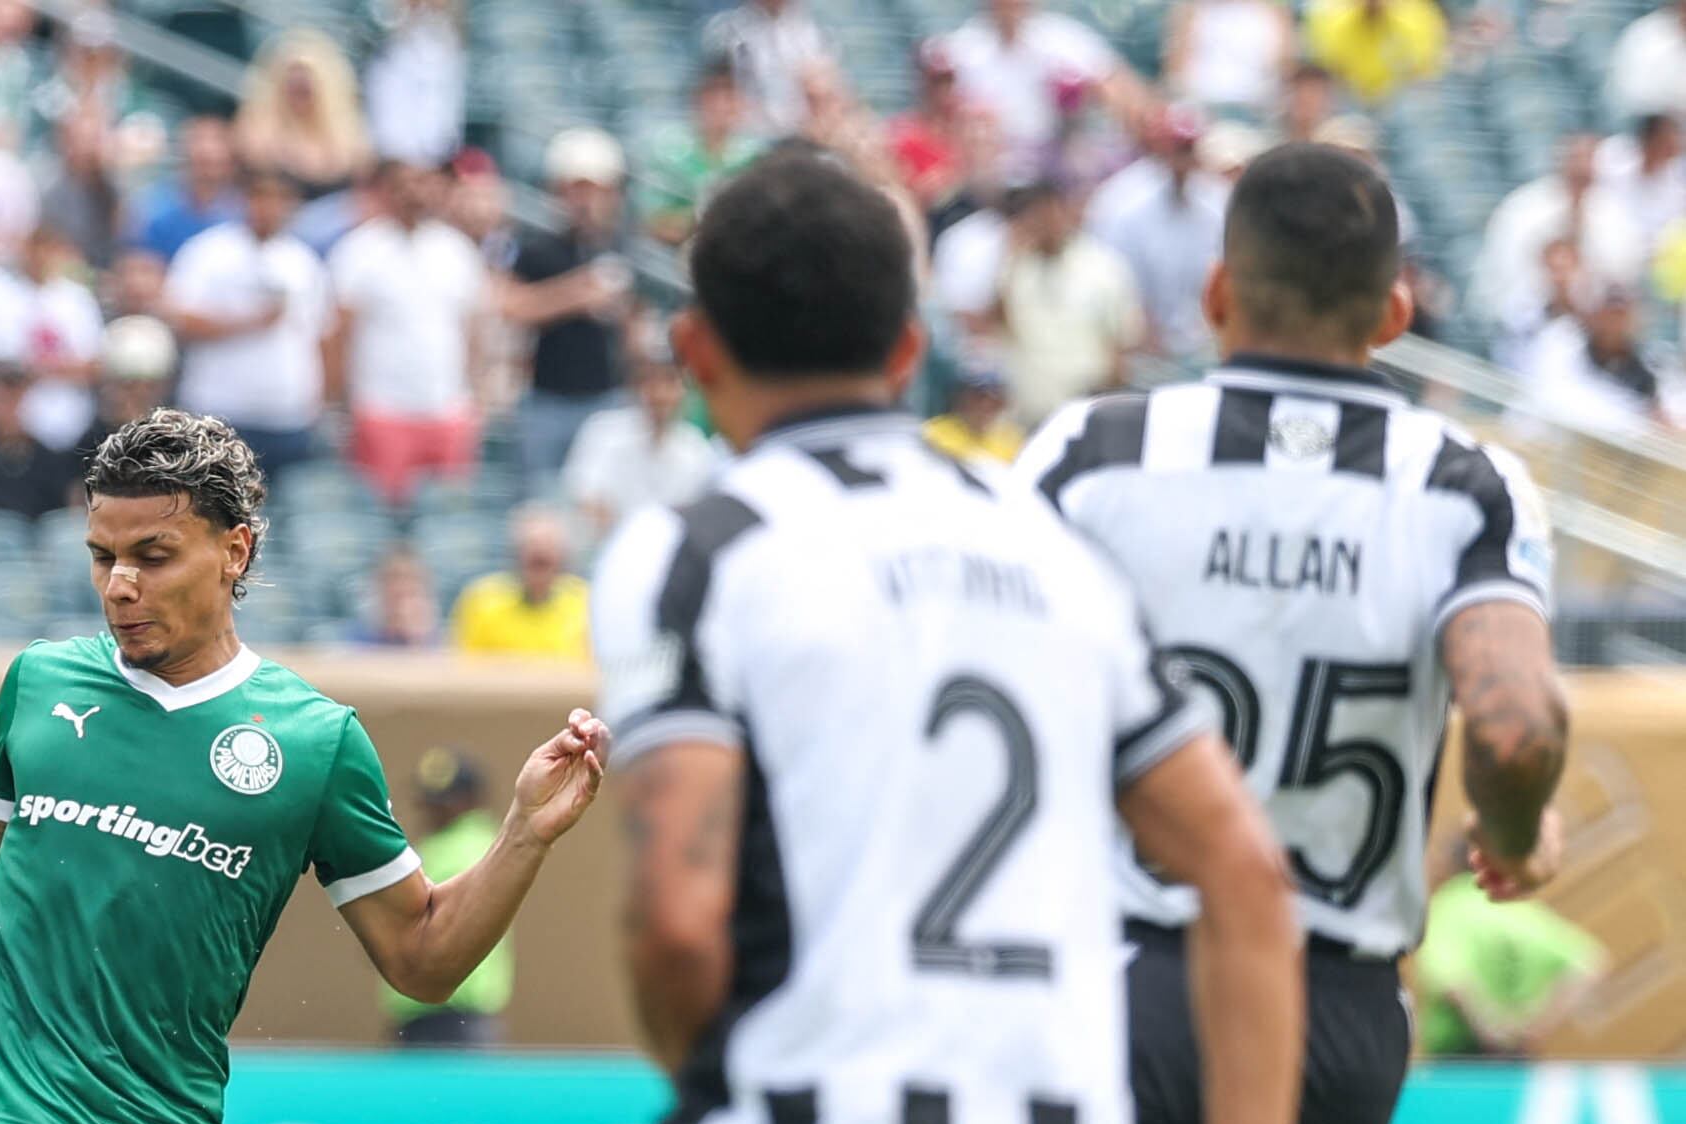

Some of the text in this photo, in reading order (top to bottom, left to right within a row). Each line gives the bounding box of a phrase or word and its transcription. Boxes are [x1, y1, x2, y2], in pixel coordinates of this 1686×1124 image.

[1203, 526, 1361, 597] ALLAN
[214, 746, 278, 790] PALMEIRAS
[18, 794, 252, 879] sportingbet
[908, 672, 1054, 978] 2
